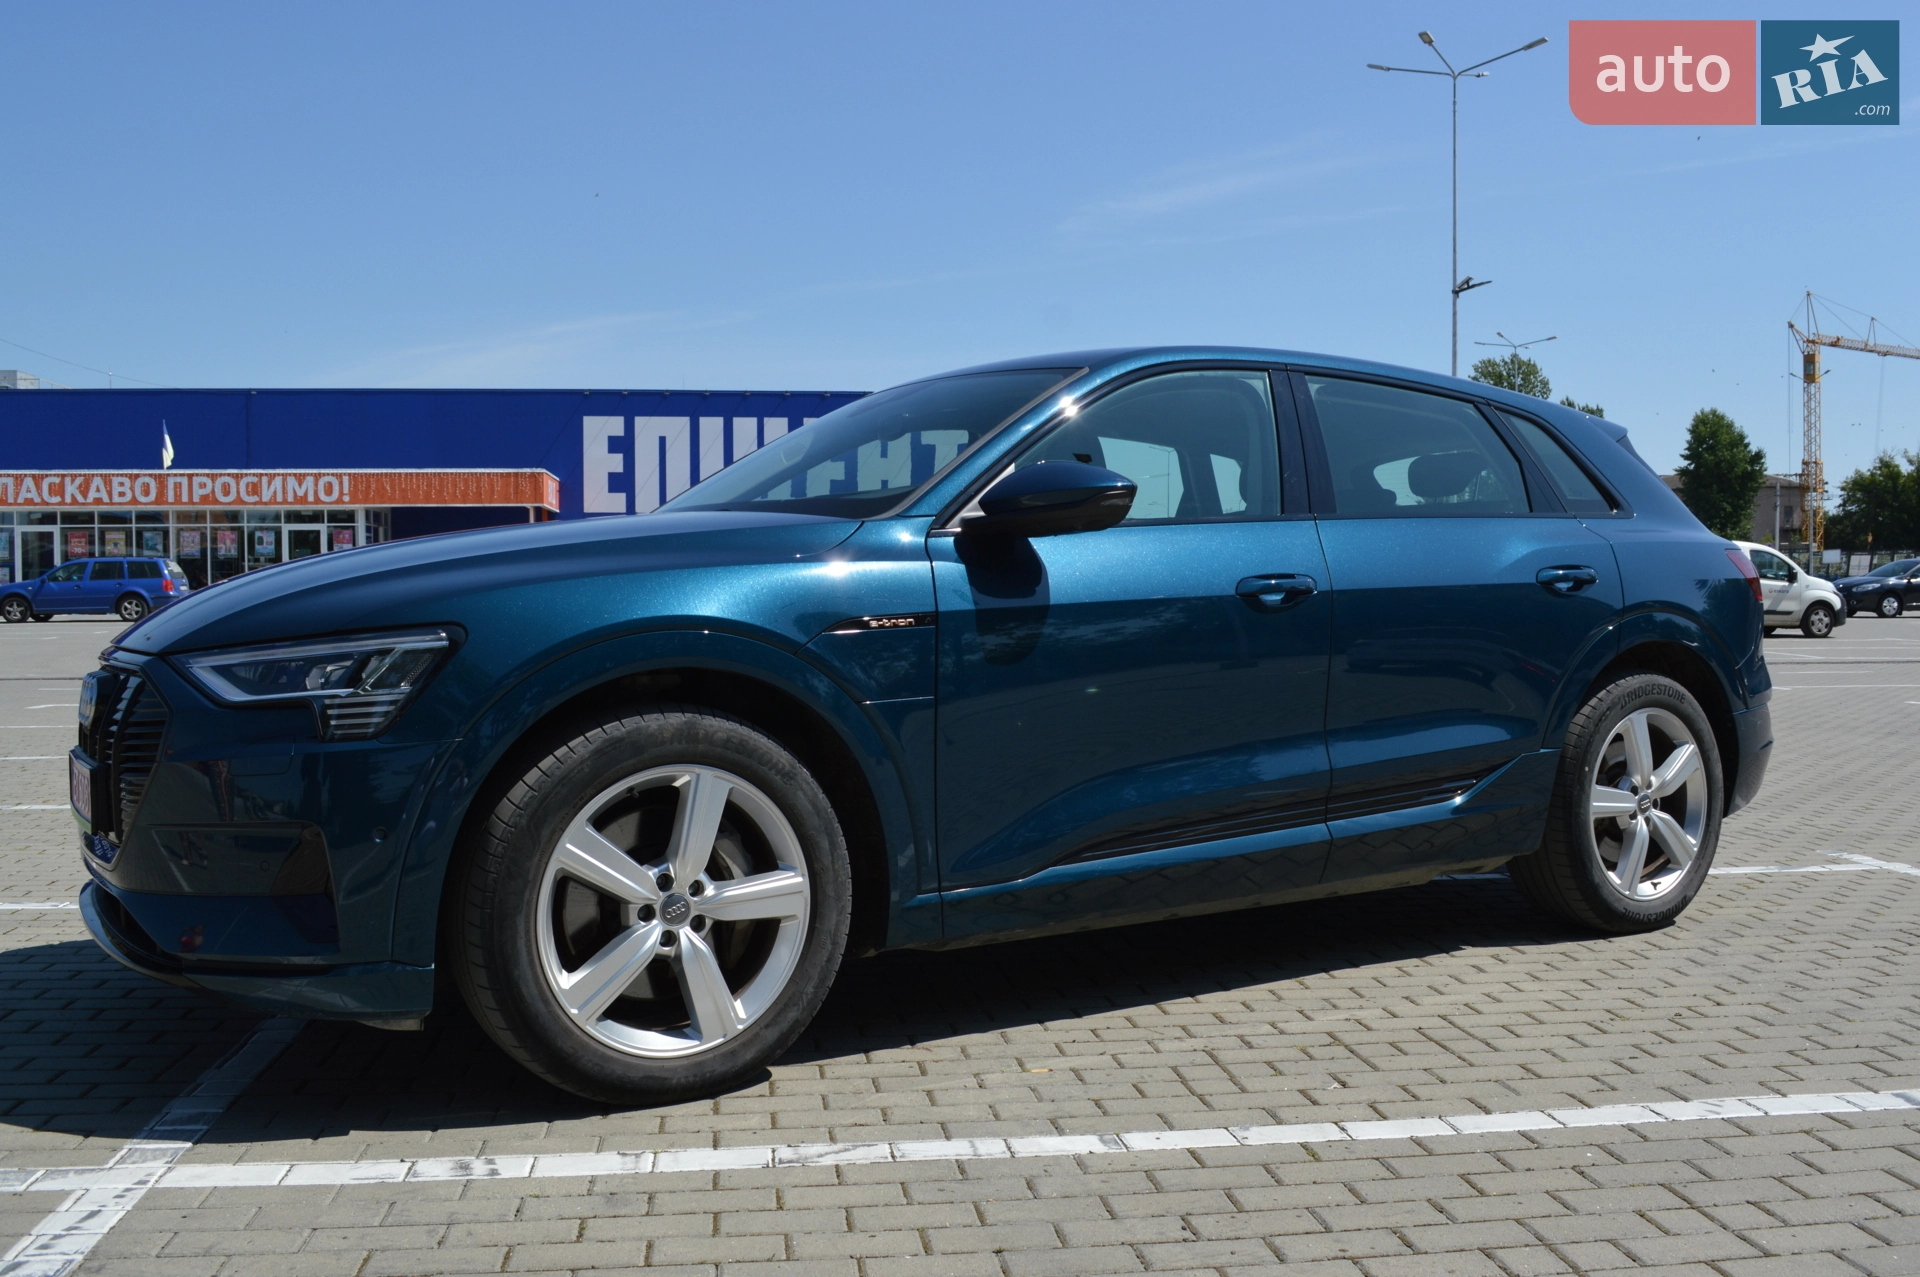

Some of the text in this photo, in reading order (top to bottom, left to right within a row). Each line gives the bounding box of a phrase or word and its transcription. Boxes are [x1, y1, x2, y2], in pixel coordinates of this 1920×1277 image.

[0, 475, 350, 504] ЛАСКАВО ПРОСИМО!
[869, 618, 915, 628] e-tron
[1619, 683, 1687, 711] BRIDGESTONE
